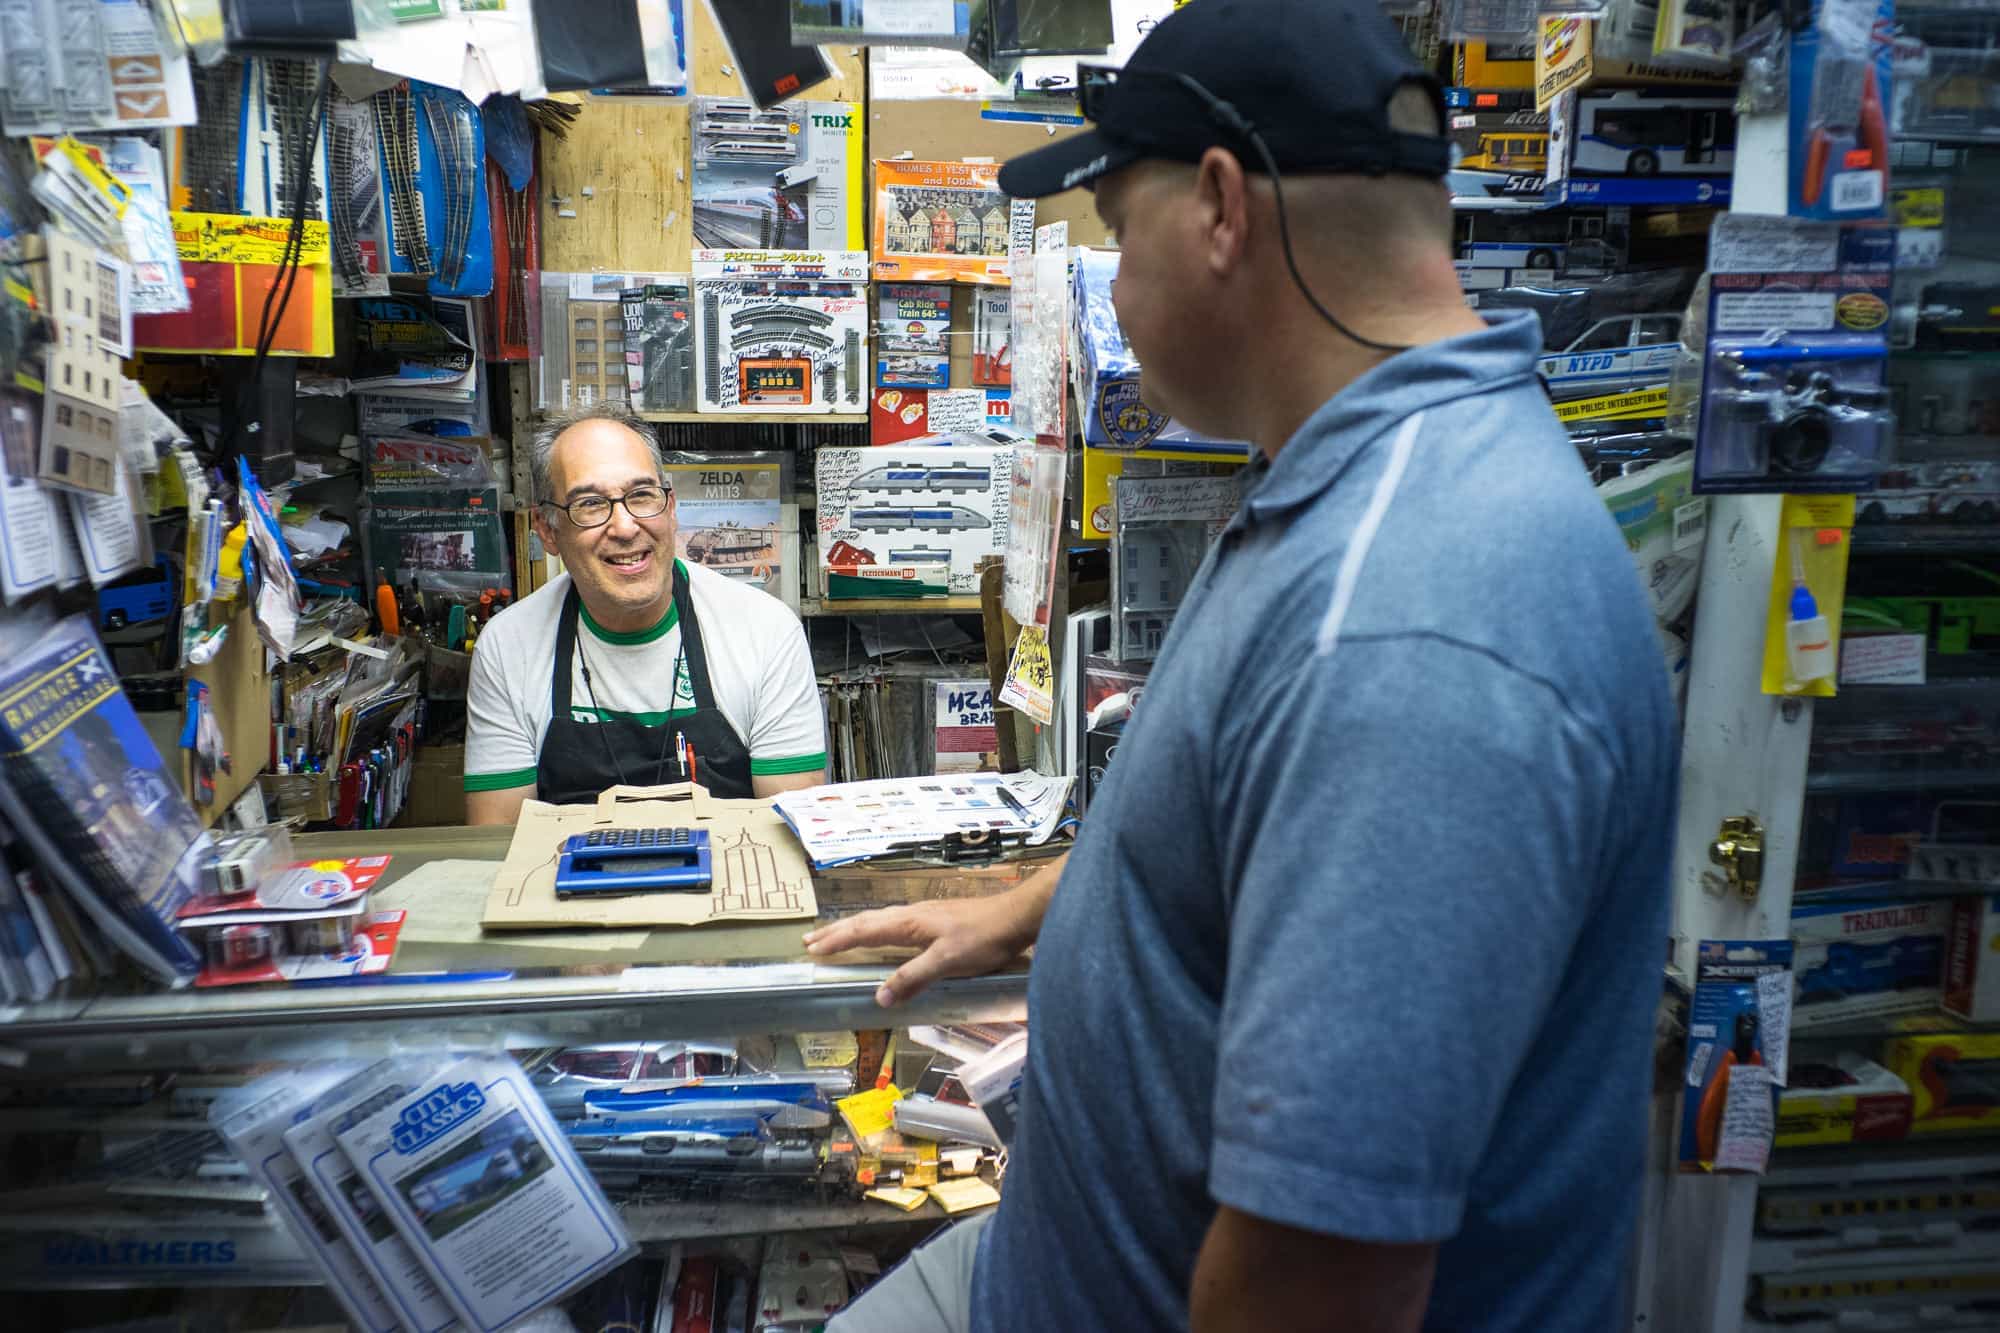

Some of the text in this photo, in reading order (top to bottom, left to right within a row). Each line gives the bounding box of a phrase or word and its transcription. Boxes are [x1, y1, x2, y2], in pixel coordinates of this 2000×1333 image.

[811, 115, 853, 128] TRIX
[923, 177, 943, 185] and
[838, 267, 862, 278] KATO
[898, 299, 935, 308] Cab Ride
[986, 301, 1008, 313] Tool
[898, 309, 937, 318] Train 645
[1567, 355, 1614, 373] NYPD
[1581, 402, 1607, 415] POLICE
[1608, 393, 1657, 409] INTERCEPTOR
[699, 471, 745, 485] ZELDA
[704, 486, 741, 498] M113
[405, 1087, 452, 1126] CITY
[394, 1089, 483, 1149] CLASSICS
[45, 1239, 238, 1265] WALTHERS
